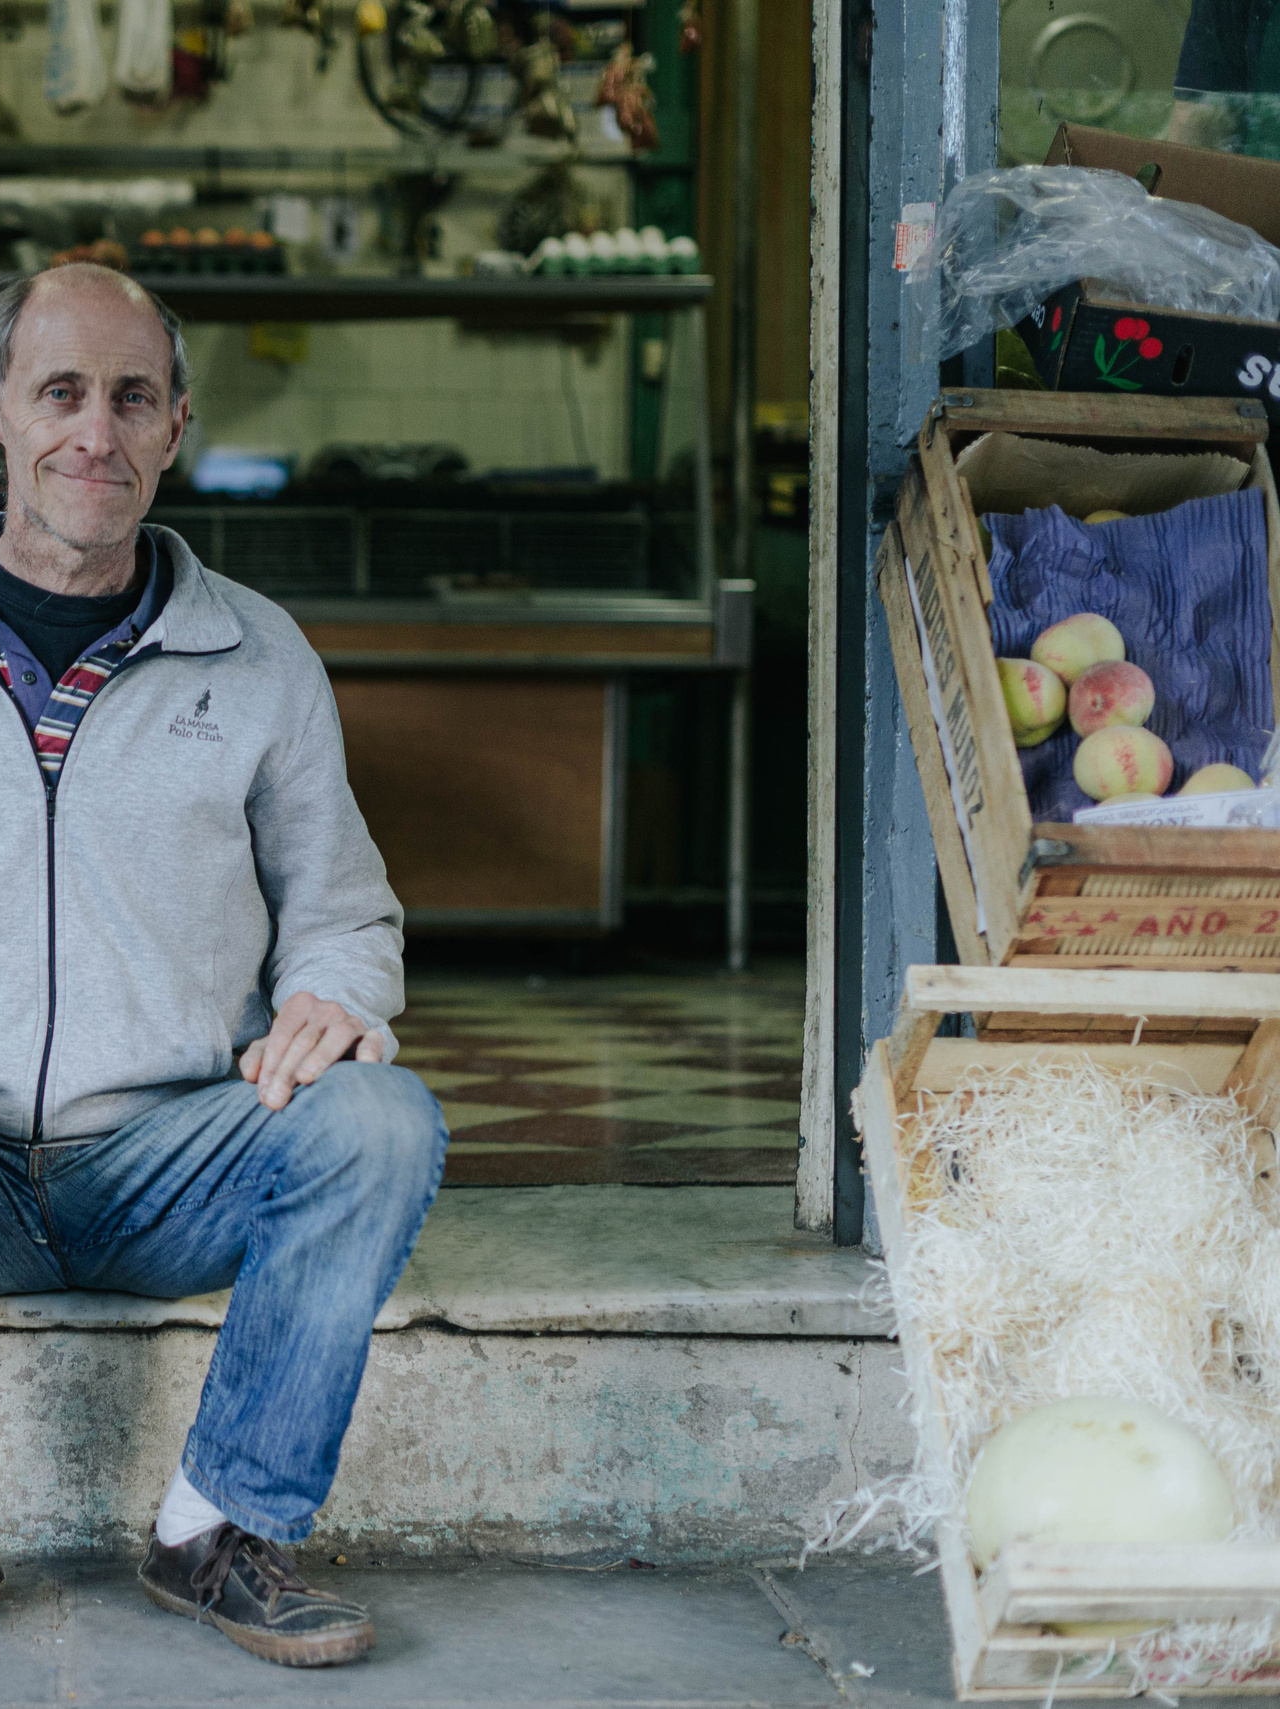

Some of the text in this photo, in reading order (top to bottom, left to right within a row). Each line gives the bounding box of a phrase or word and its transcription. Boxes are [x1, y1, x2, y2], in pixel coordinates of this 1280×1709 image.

[168, 723, 224, 743] Polo Club
[1132, 905, 1228, 937] AÑO
